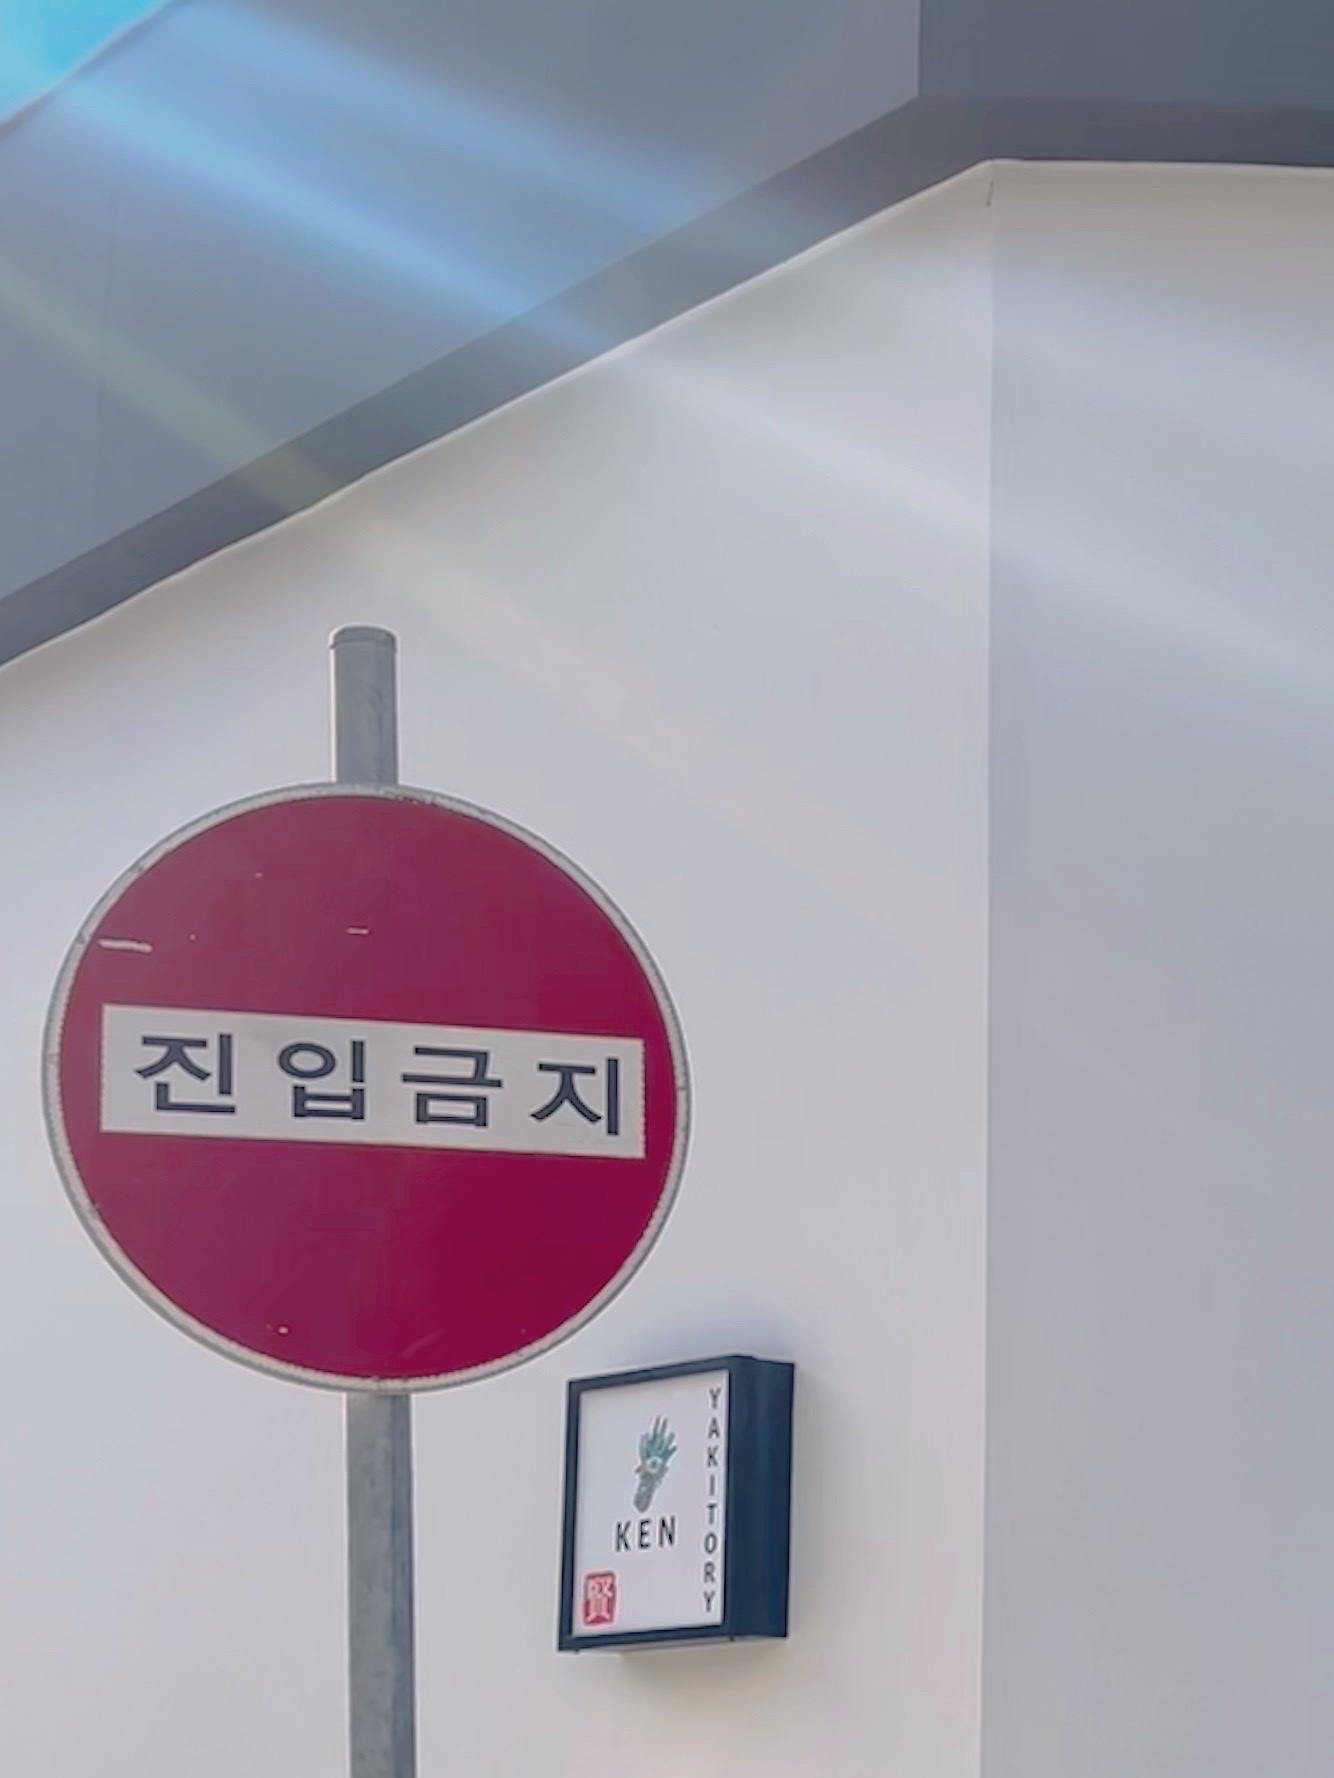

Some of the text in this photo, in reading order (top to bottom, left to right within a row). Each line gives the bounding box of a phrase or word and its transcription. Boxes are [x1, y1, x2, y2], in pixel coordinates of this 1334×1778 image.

[134, 1032, 620, 1136] 진입금지
[615, 1515, 677, 1553] KEN
[702, 1387, 722, 1614] YAKITORY
